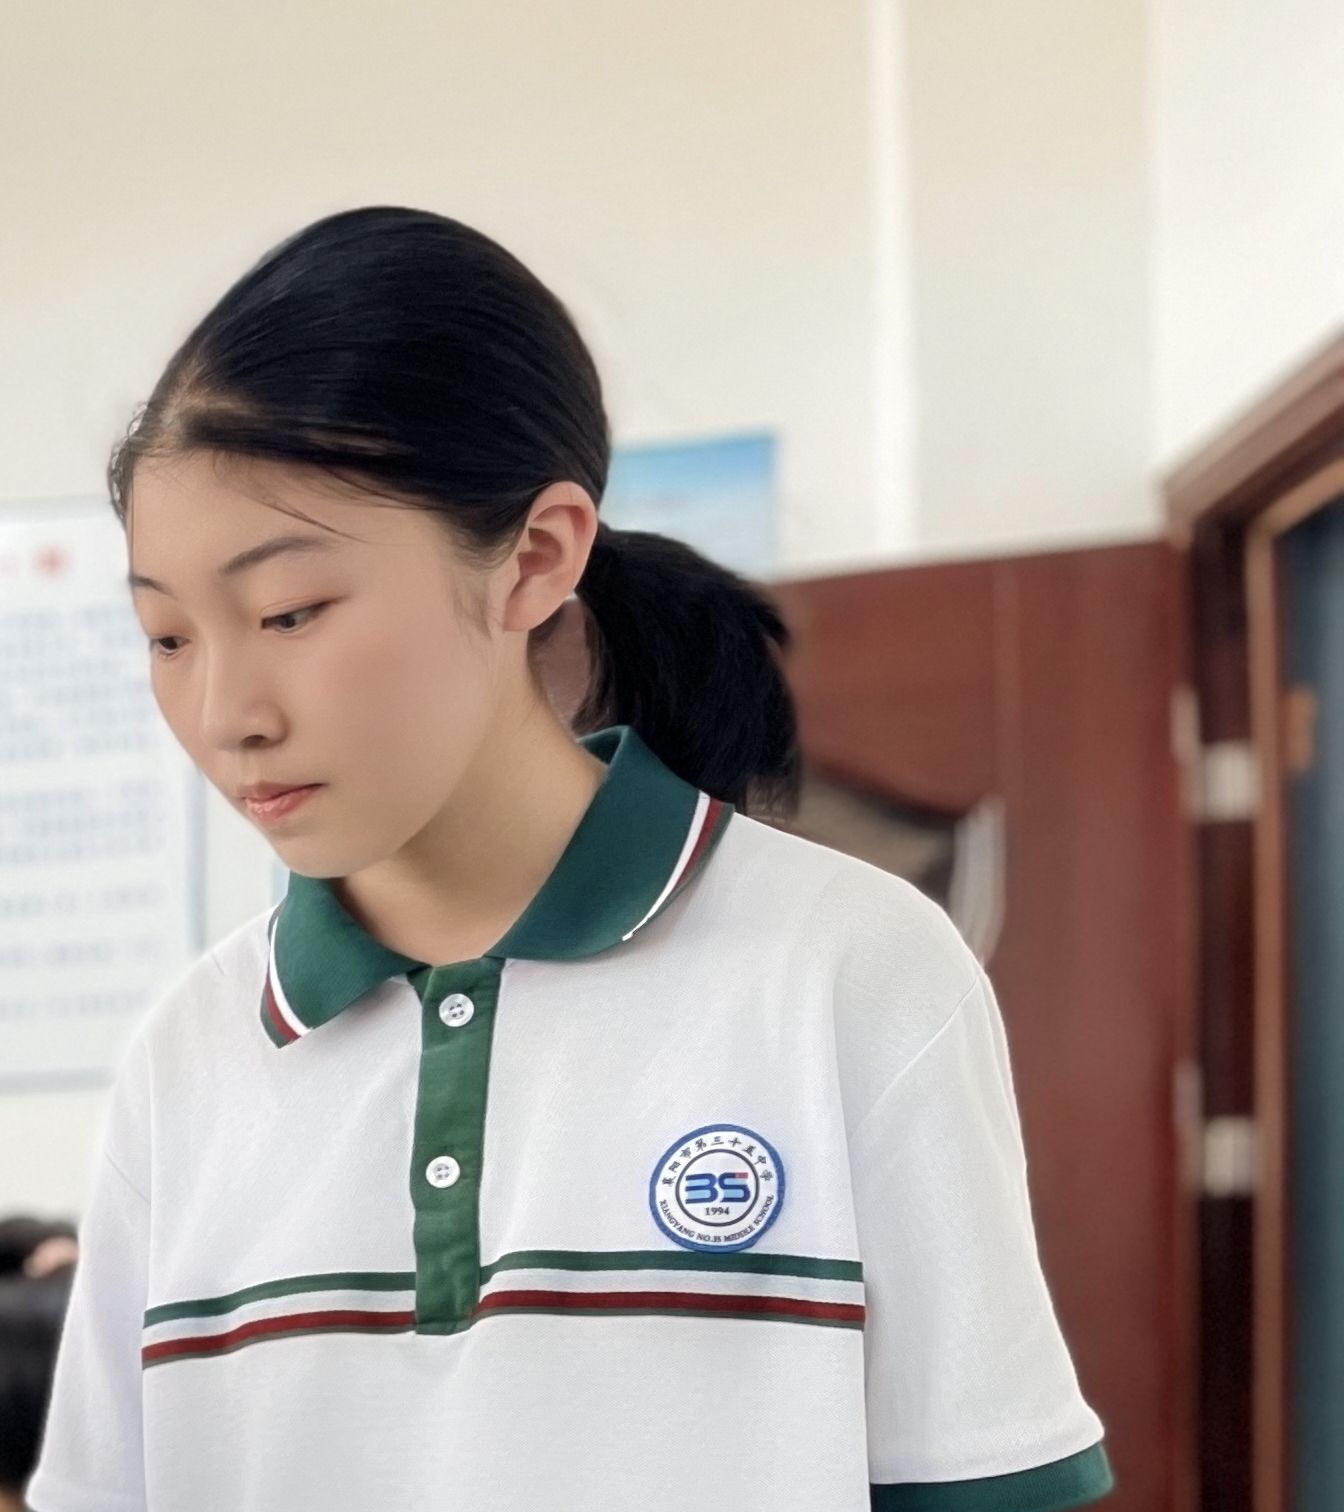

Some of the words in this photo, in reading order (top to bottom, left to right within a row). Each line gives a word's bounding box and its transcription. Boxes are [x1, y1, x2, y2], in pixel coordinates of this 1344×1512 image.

[662, 1136, 774, 1187] 襄阳市第三十五中学
[658, 1199, 695, 1239] XIANGYANG
[696, 1233, 722, 1243] NO.35
[723, 1225, 754, 1243] MIDDLE
[754, 1194, 775, 1226] SCHOOL
[704, 1207, 730, 1216] 1994
